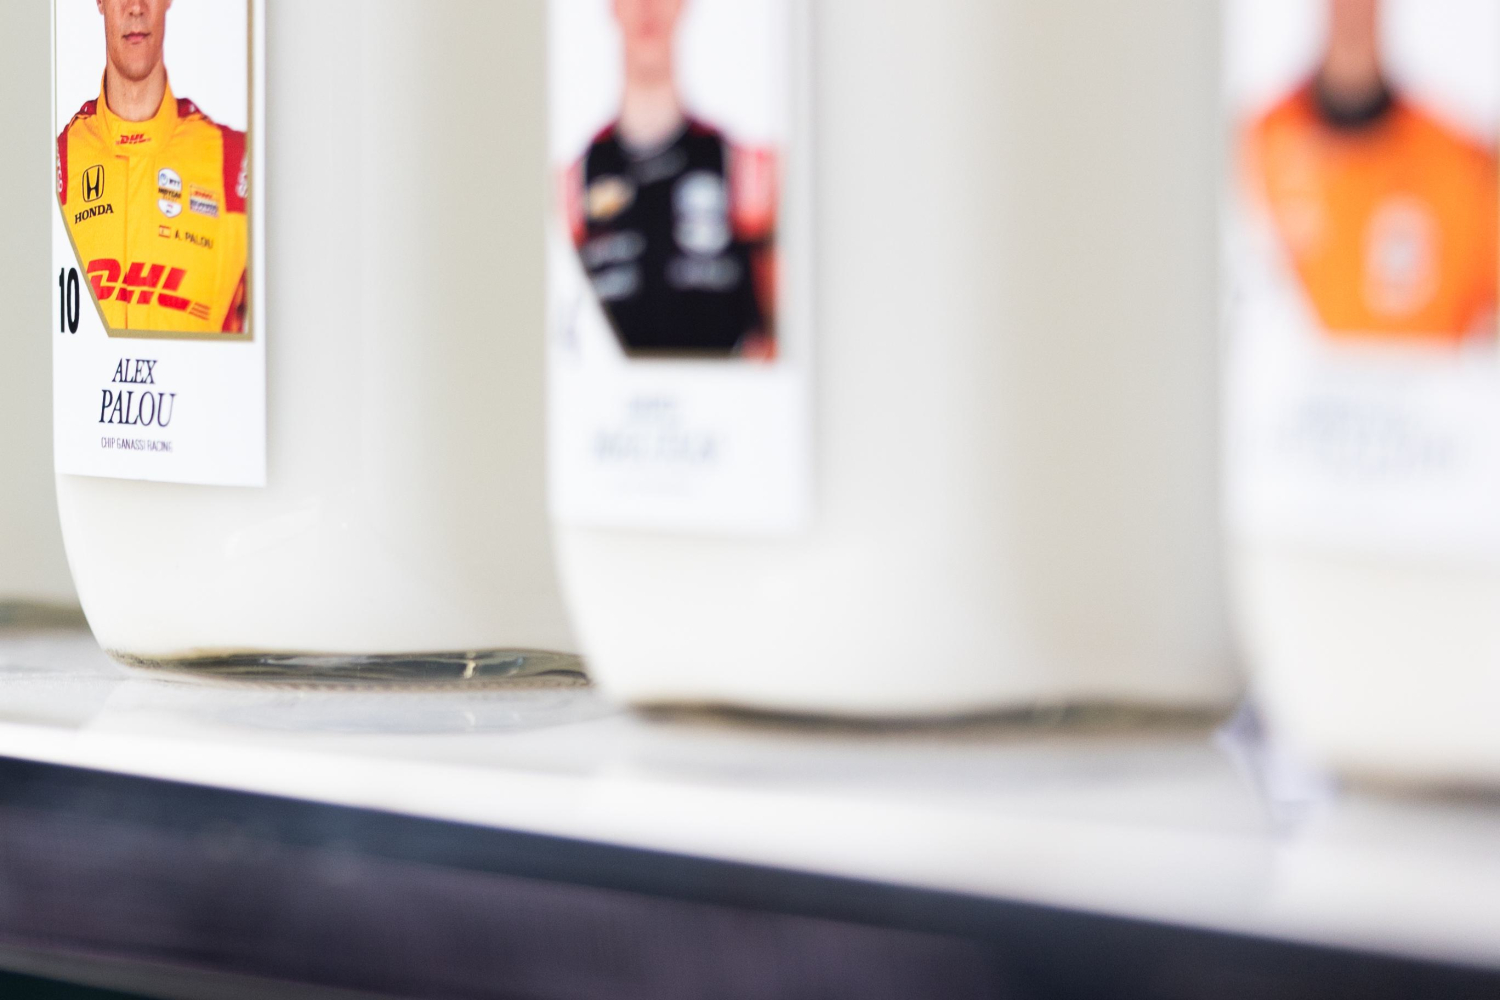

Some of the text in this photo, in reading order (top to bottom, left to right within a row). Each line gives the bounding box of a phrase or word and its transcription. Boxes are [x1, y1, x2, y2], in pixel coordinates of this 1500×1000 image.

[119, 133, 146, 145] DHL
[74, 203, 114, 224] HONDA
[86, 258, 192, 313] DHL
[59, 267, 80, 335] 10
[111, 357, 158, 385] ALEX
[98, 389, 177, 428] PALOU
[101, 436, 116, 449] CHIP
